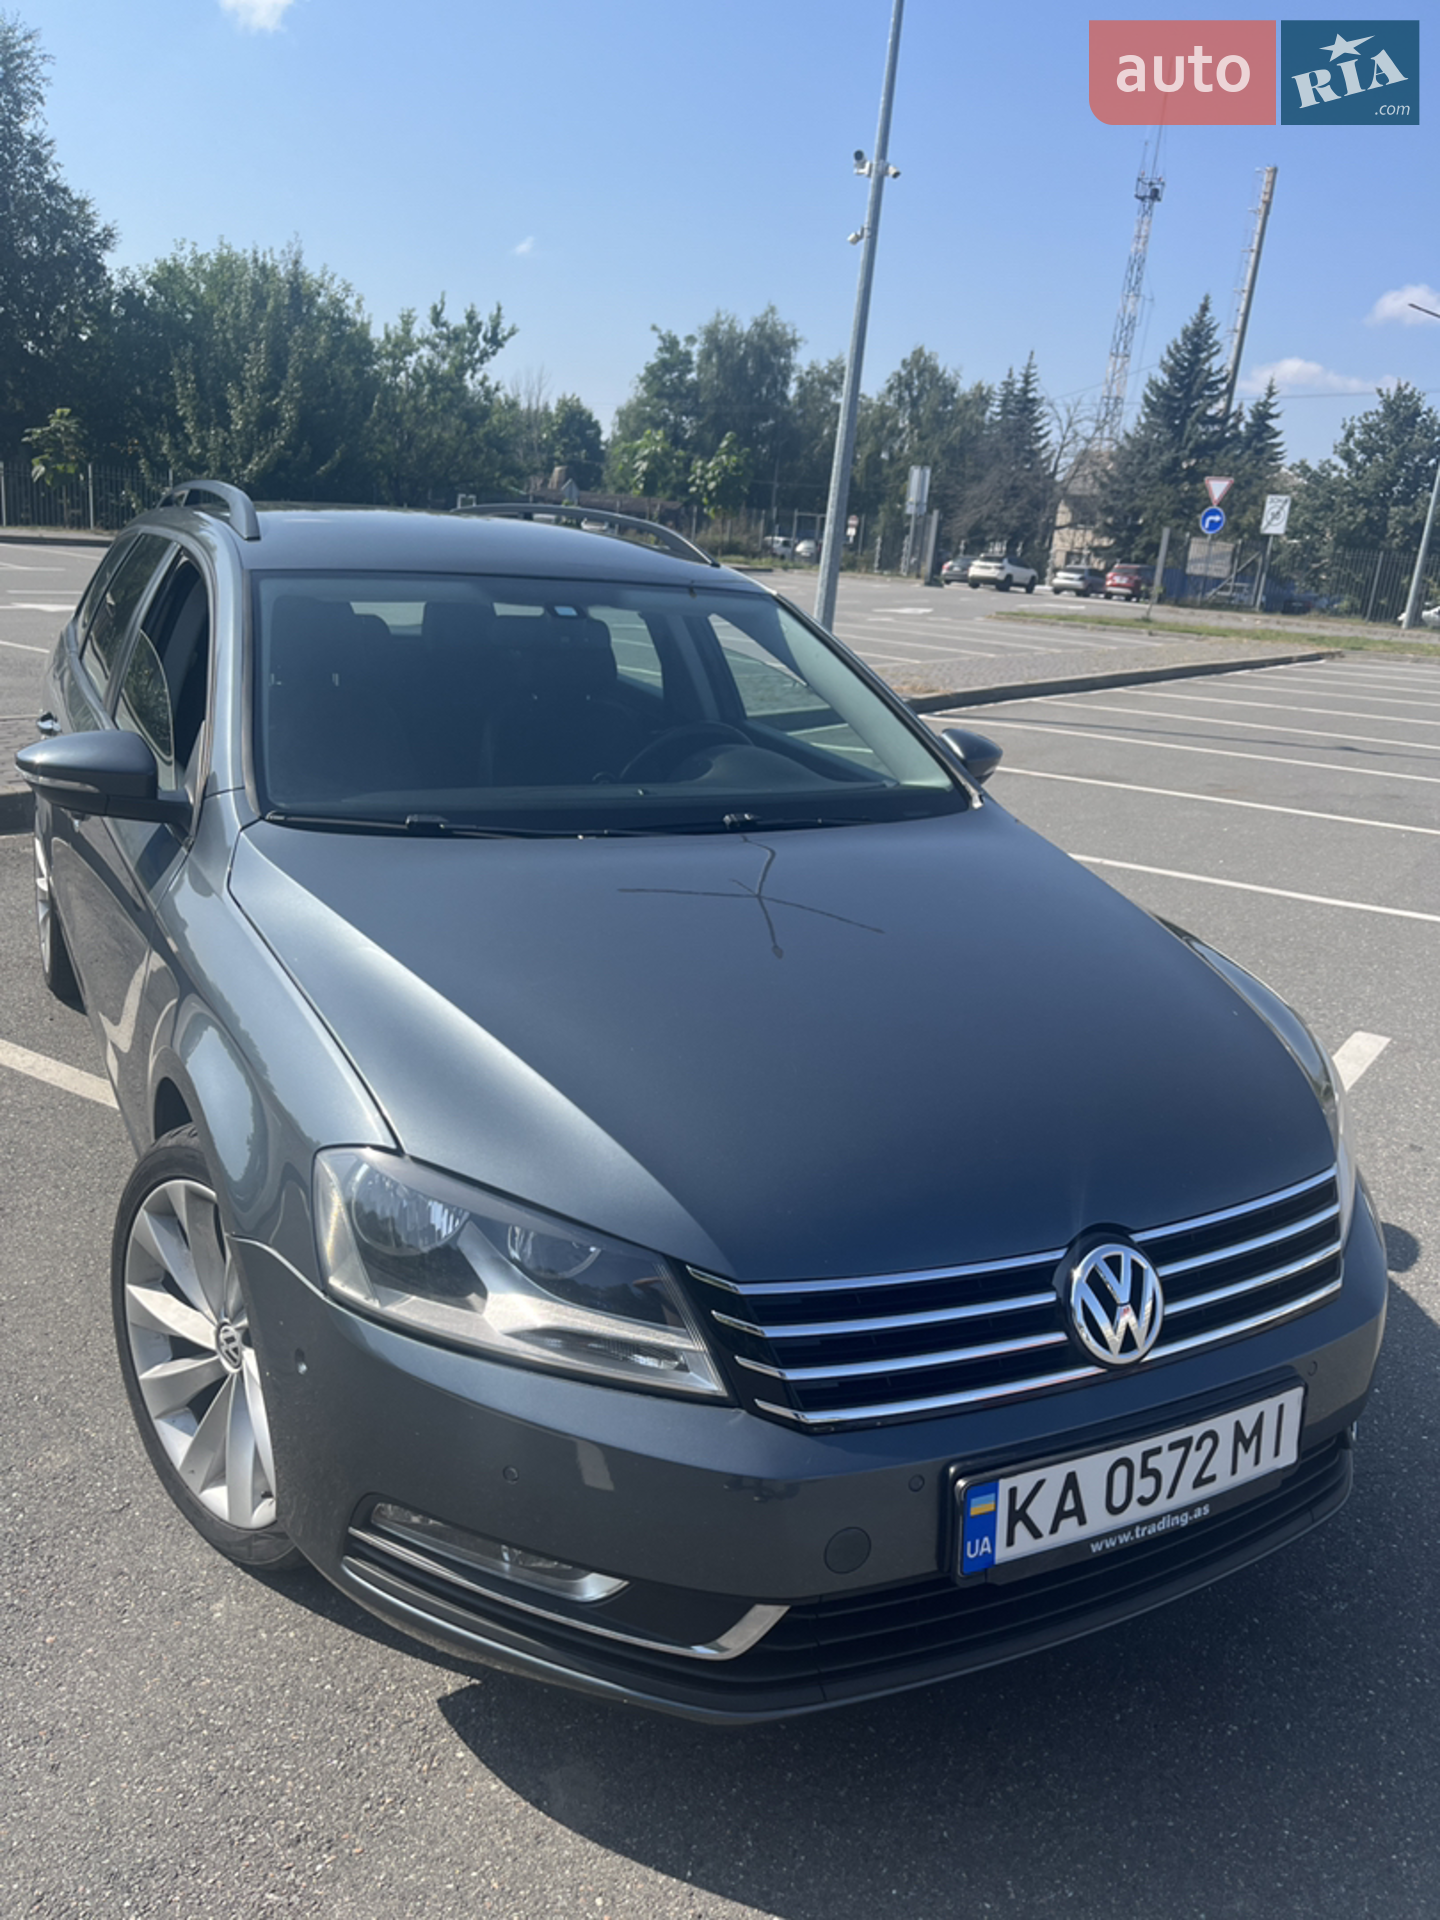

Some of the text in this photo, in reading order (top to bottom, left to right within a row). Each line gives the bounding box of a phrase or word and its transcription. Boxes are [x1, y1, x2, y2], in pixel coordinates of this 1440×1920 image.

[1006, 1403, 1284, 1547] KA 0572 MI
[966, 1536, 992, 1558] UA
[1090, 1503, 1210, 1553] www.trading.as
